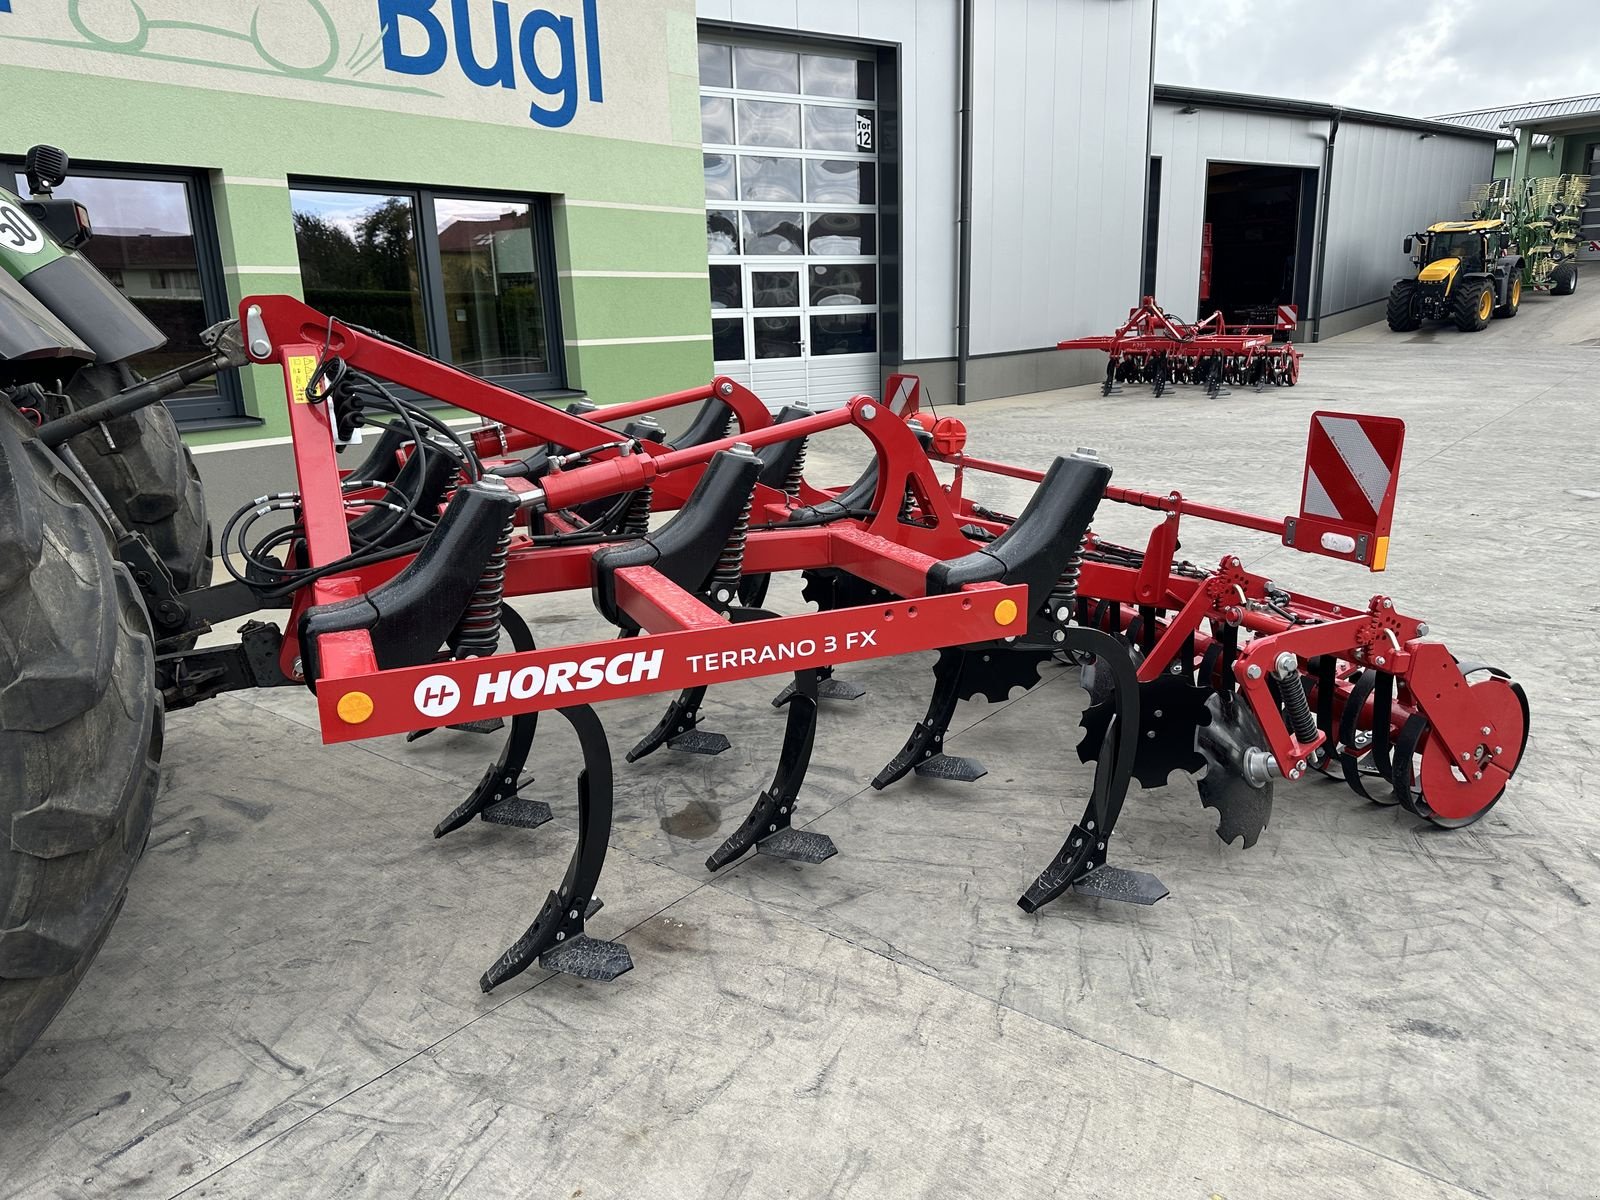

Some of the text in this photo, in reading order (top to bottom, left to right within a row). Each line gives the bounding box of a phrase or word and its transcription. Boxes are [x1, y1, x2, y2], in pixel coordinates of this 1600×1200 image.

[857, 121, 871, 130] Tor
[857, 131, 871, 145] 12
[472, 629, 877, 706] HORSCH TERRANO 3 FX
